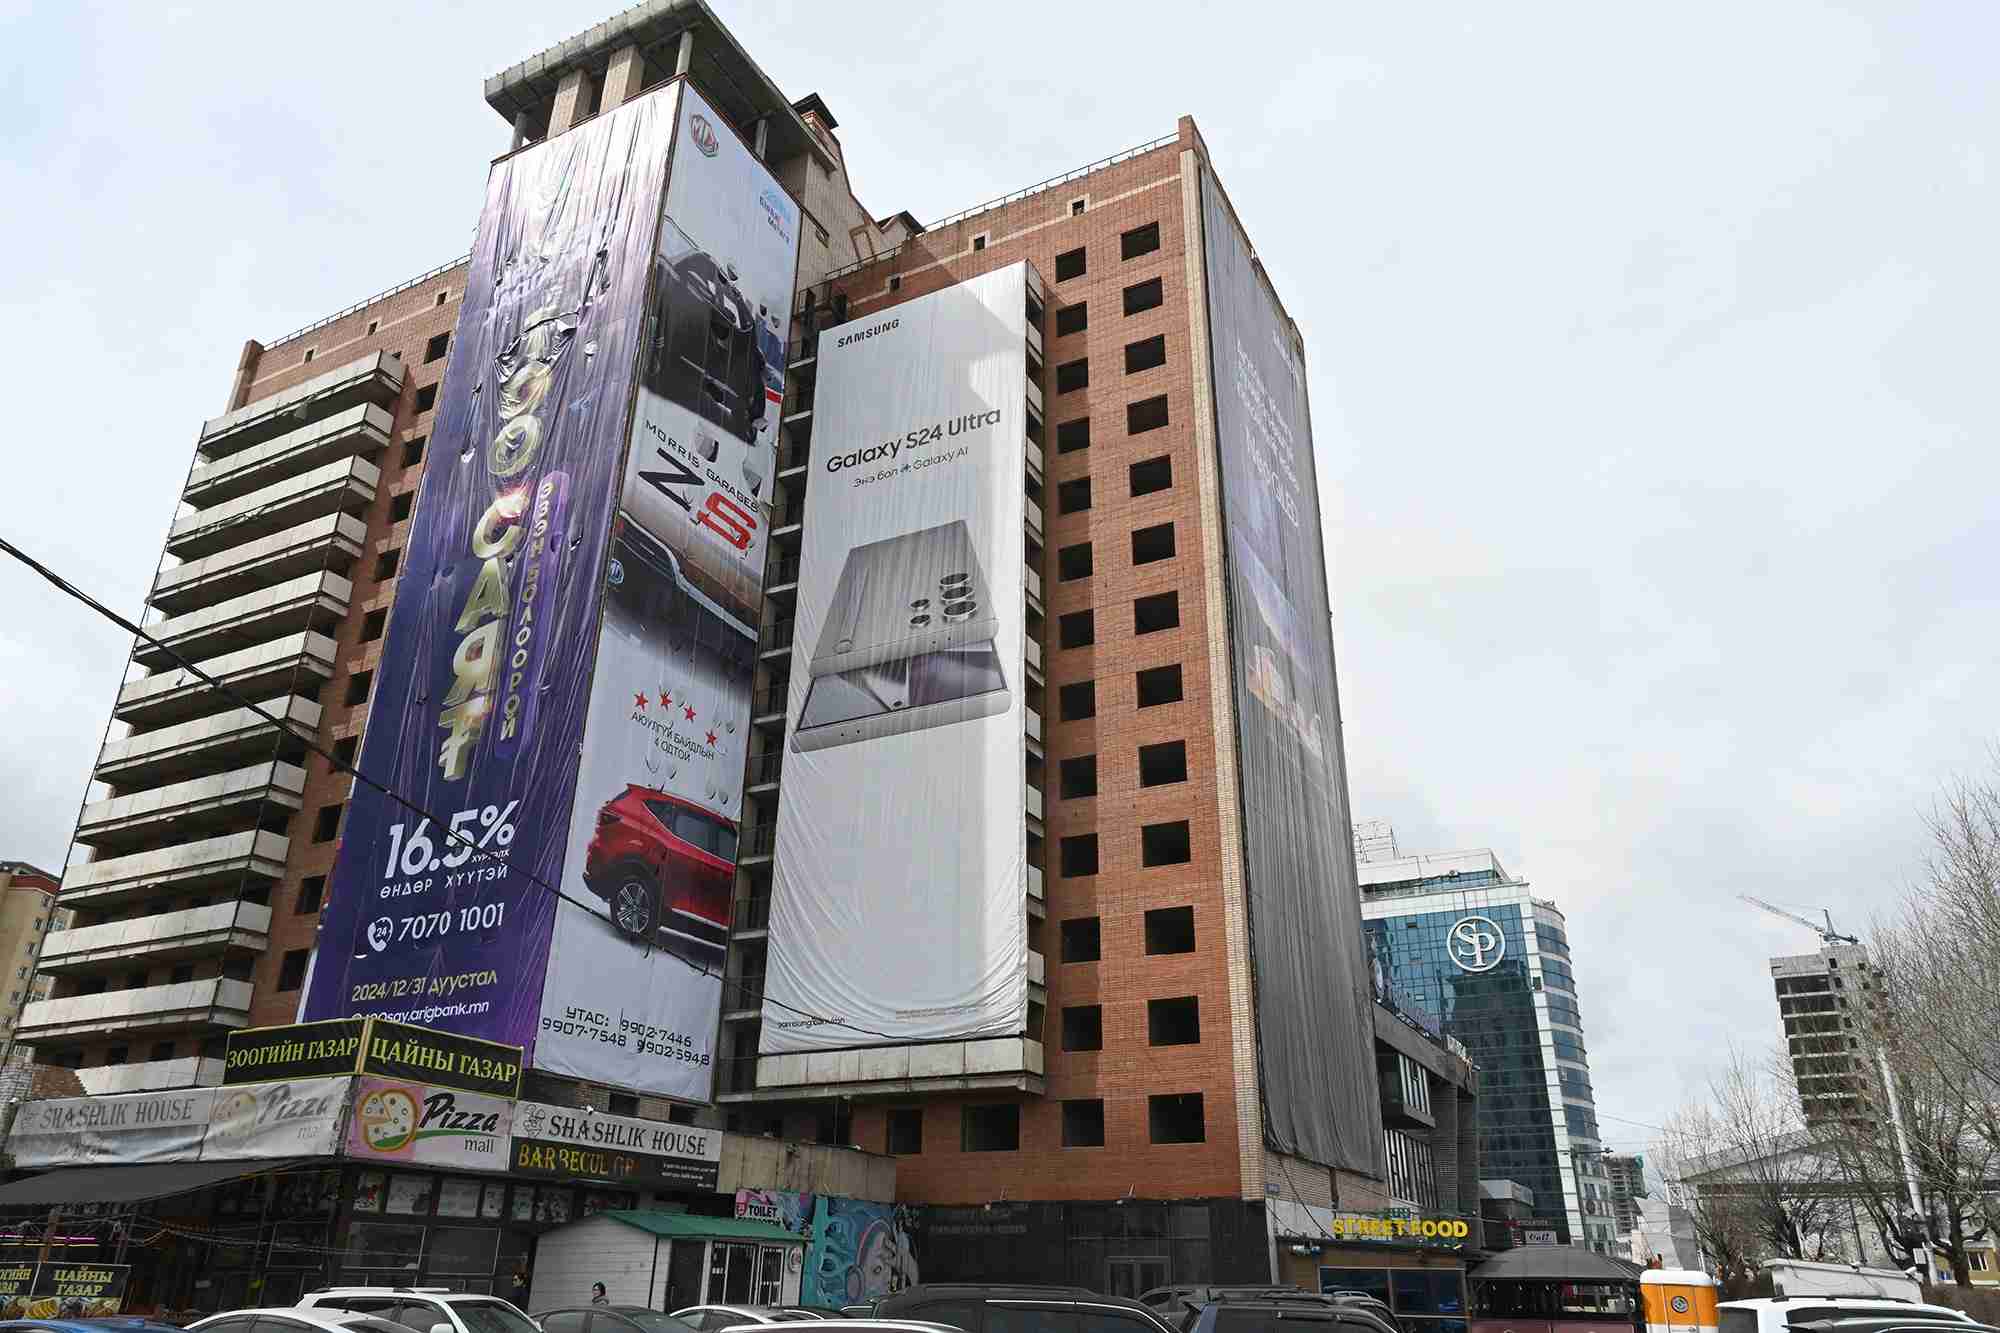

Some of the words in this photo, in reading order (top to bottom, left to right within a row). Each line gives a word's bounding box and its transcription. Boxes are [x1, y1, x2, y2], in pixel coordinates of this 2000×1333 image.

[837, 319, 900, 347] SAMSUNG
[827, 438, 902, 472] Galaxy
[906, 424, 943, 449] S24
[948, 409, 1001, 436] Ultra
[646, 420, 700, 468] MORRIS
[705, 468, 760, 513] GARAGES
[913, 451, 955, 470] Galaxy
[384, 800, 519, 879] 16.5%
[380, 878, 433, 899] ӨНДӨР
[444, 862, 508, 889] ХҮҮТЭЙ
[398, 911, 451, 941] 7070
[459, 902, 505, 932] 1001
[351, 976, 427, 1002] 2024/12/31
[566, 1006, 609, 1027] УТАС:
[542, 1017, 627, 1048] 9907-7548
[227, 1039, 303, 1069] ЗООГИЙН
[307, 1038, 359, 1061] ГАЗАР
[371, 1037, 454, 1072] ЦАЙНЫ
[459, 1054, 518, 1083] ГАЗАР
[135, 1098, 195, 1124] HOUSE
[419, 1093, 499, 1132] Pizza
[464, 1138, 494, 1153] mall
[549, 1114, 646, 1149] SHASHLIK
[652, 1131, 707, 1156] HOUSE
[748, 1204, 777, 1217] TOILET
[54, 1265, 113, 1283] ЦАЙНЫ
[56, 1283, 104, 1296] ГАЗАР
